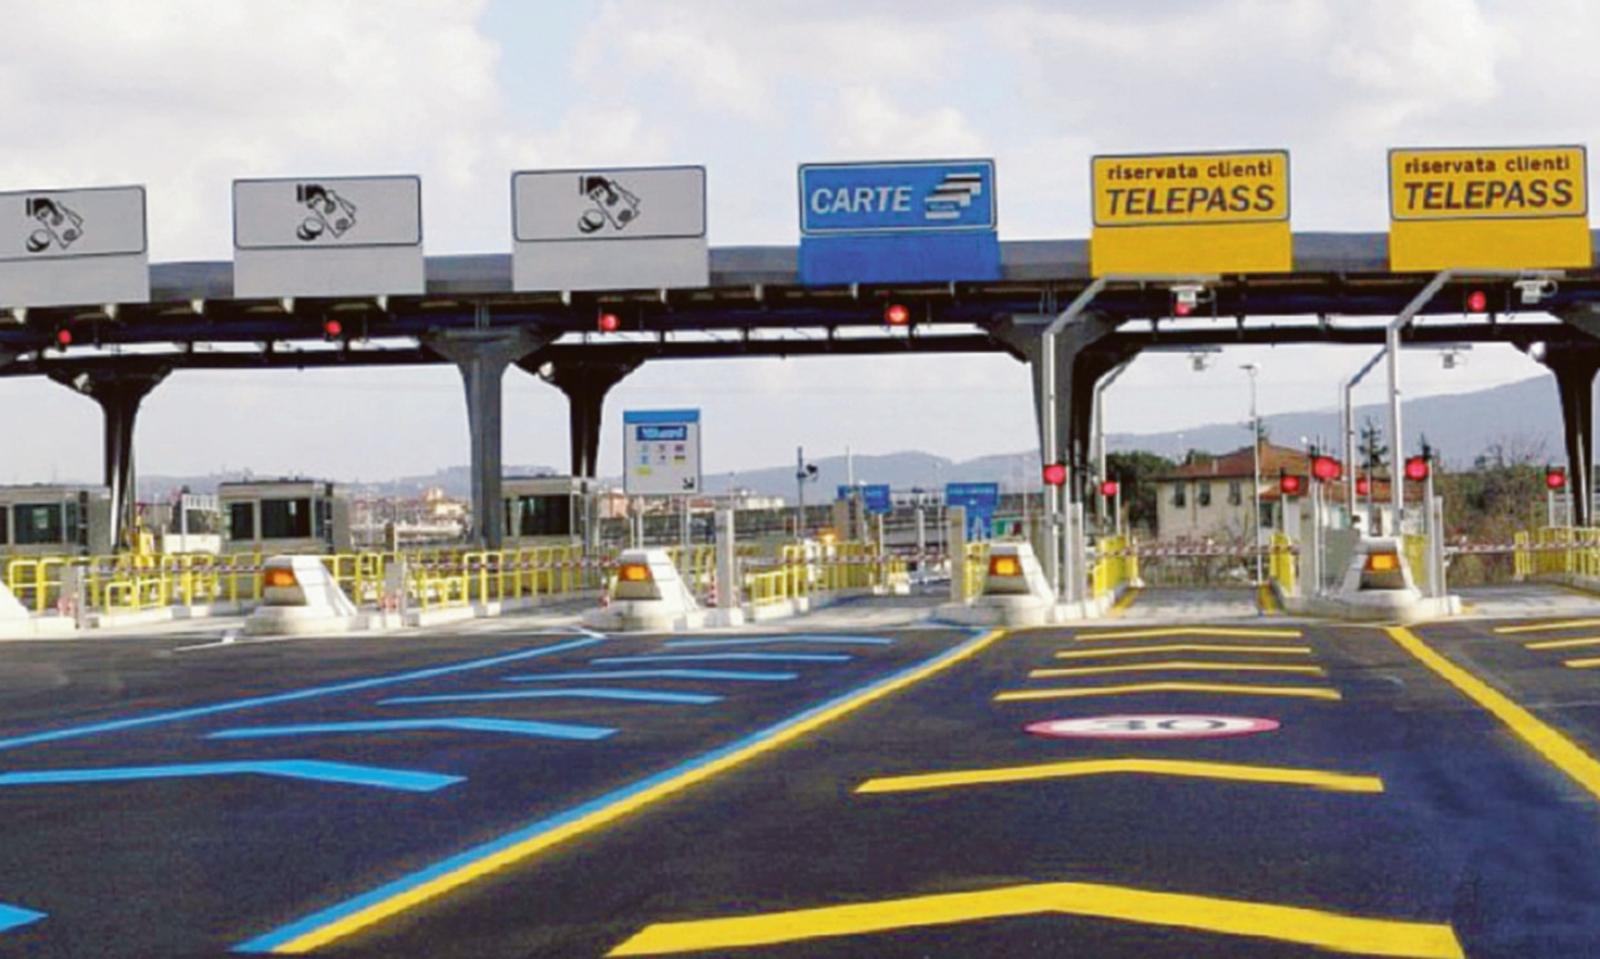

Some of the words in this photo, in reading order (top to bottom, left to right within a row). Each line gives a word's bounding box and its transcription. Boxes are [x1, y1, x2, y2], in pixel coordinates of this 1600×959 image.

[1107, 163, 1198, 180] riservata
[1207, 160, 1272, 178] clienti
[1405, 157, 1496, 173] riservata
[1505, 155, 1570, 172] clienti
[811, 186, 913, 214] CARTE
[1106, 184, 1275, 215] TELEPASS
[1404, 178, 1573, 210] TELEPASS
